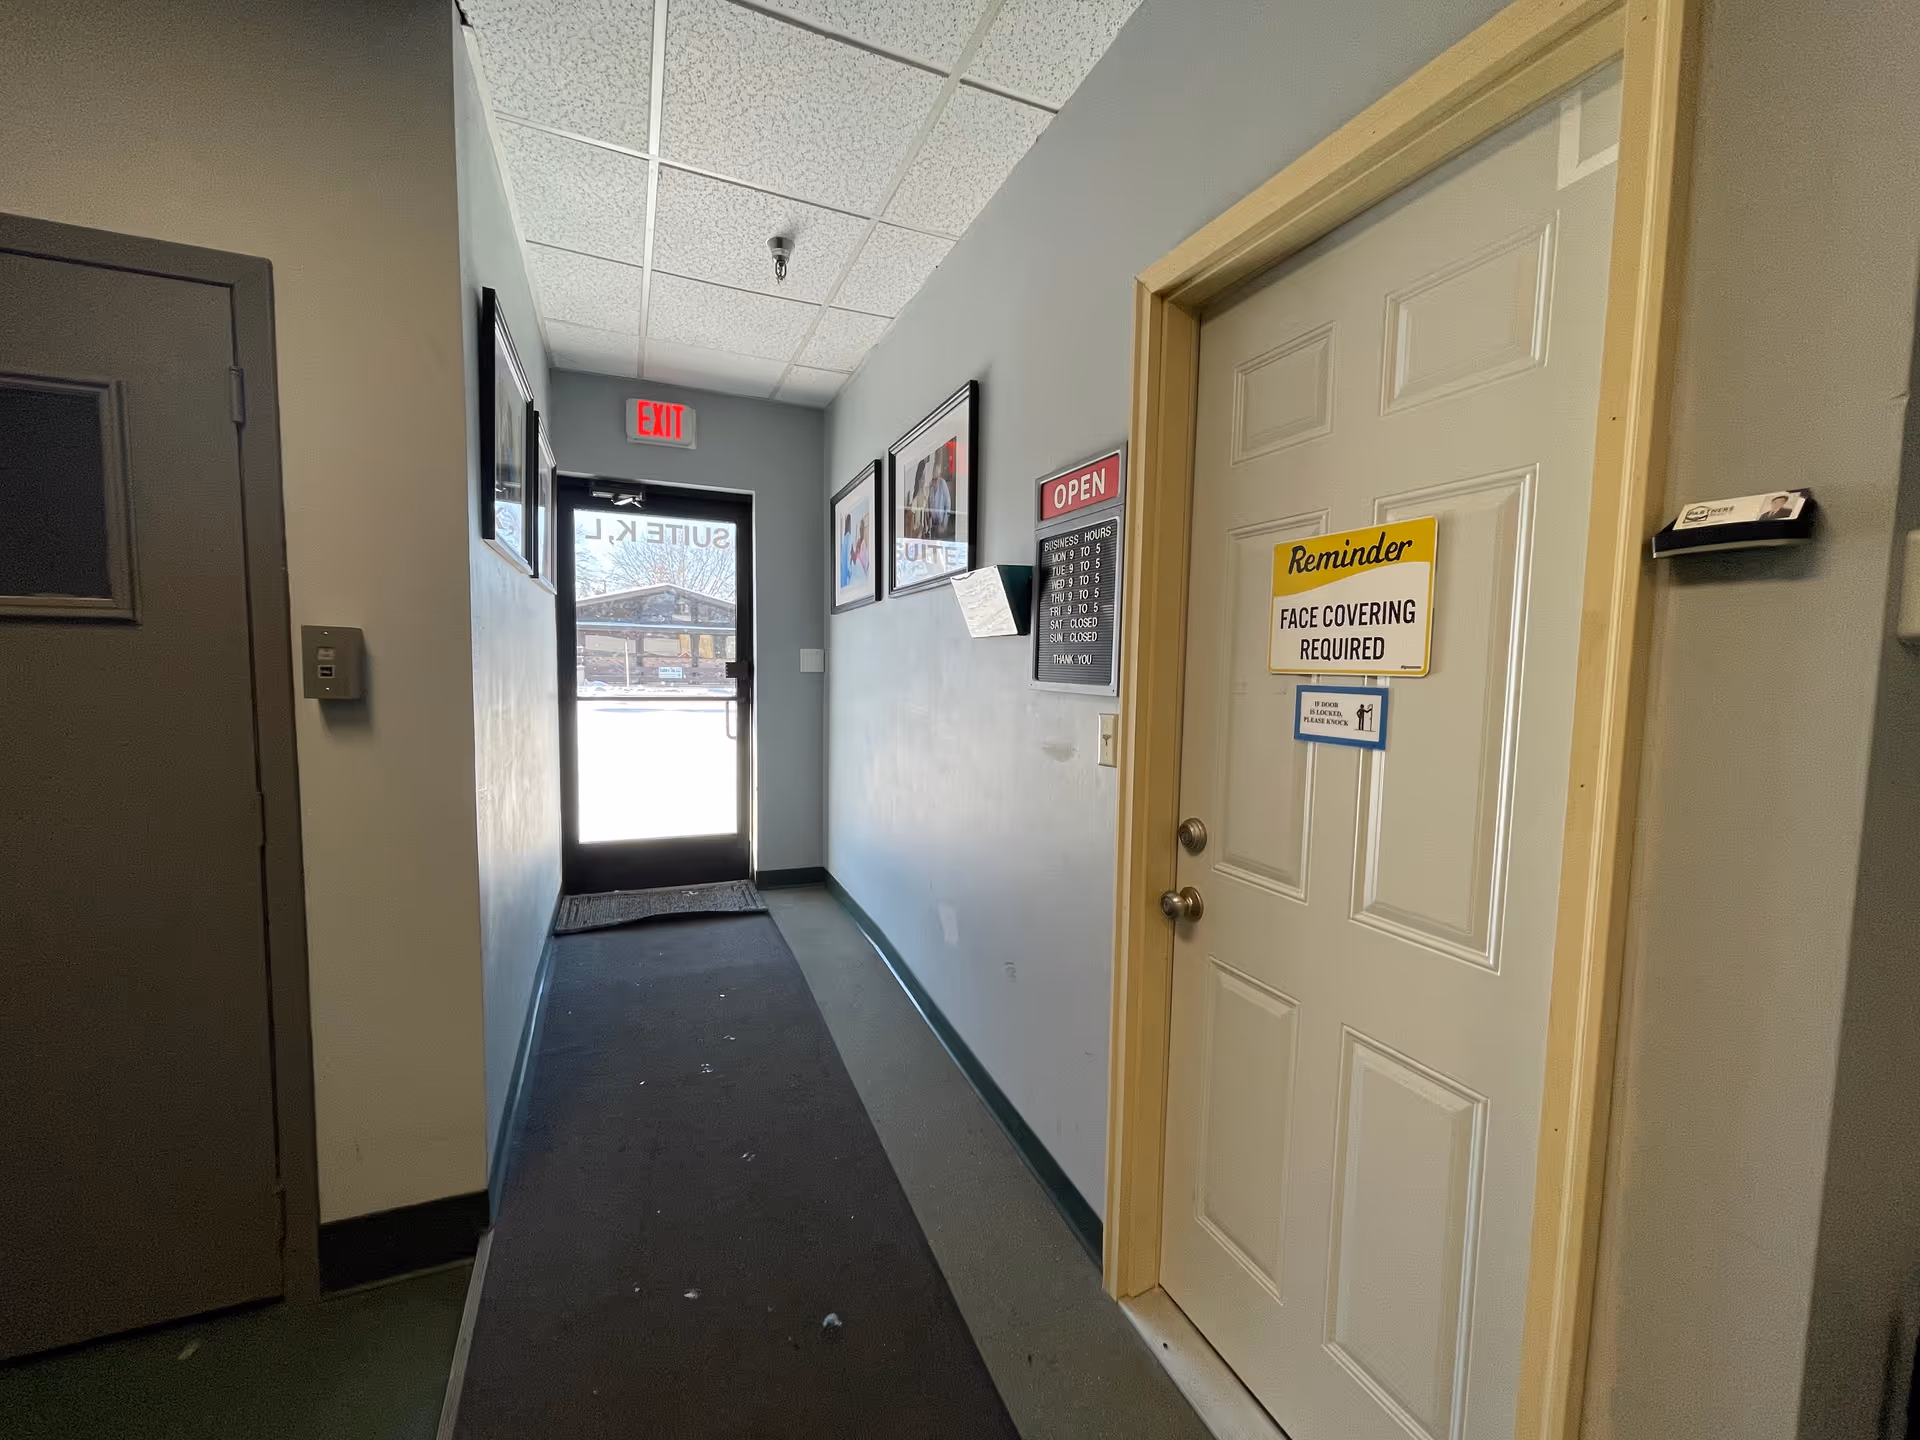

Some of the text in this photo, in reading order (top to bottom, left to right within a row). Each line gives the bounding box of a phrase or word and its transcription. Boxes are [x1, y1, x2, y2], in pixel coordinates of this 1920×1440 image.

[637, 400, 685, 440] EXIT
[1054, 467, 1106, 509] OPEN
[1044, 526, 1112, 552] BUSINESS HOURS
[1052, 543, 1101, 562] MON 9 TO 5
[1288, 531, 1413, 575] Reminder
[1052, 558, 1100, 576] TUE 9 TO 5
[1051, 573, 1100, 590] WED 9 TO 5
[1051, 588, 1100, 603] THU 9 TO 5
[1050, 602, 1099, 616] FRI 9 TO 5
[1280, 599, 1416, 630] FACE COVERING
[1050, 617, 1098, 630] SAT CLOSED
[1050, 631, 1098, 643] SUN CLOSED
[1300, 636, 1385, 662] REQUIRED
[1053, 654, 1092, 665] THANK YOU
[1303, 716, 1349, 727] PLEASE KNOCK
[1316, 709, 1343, 718] LOCKED,
